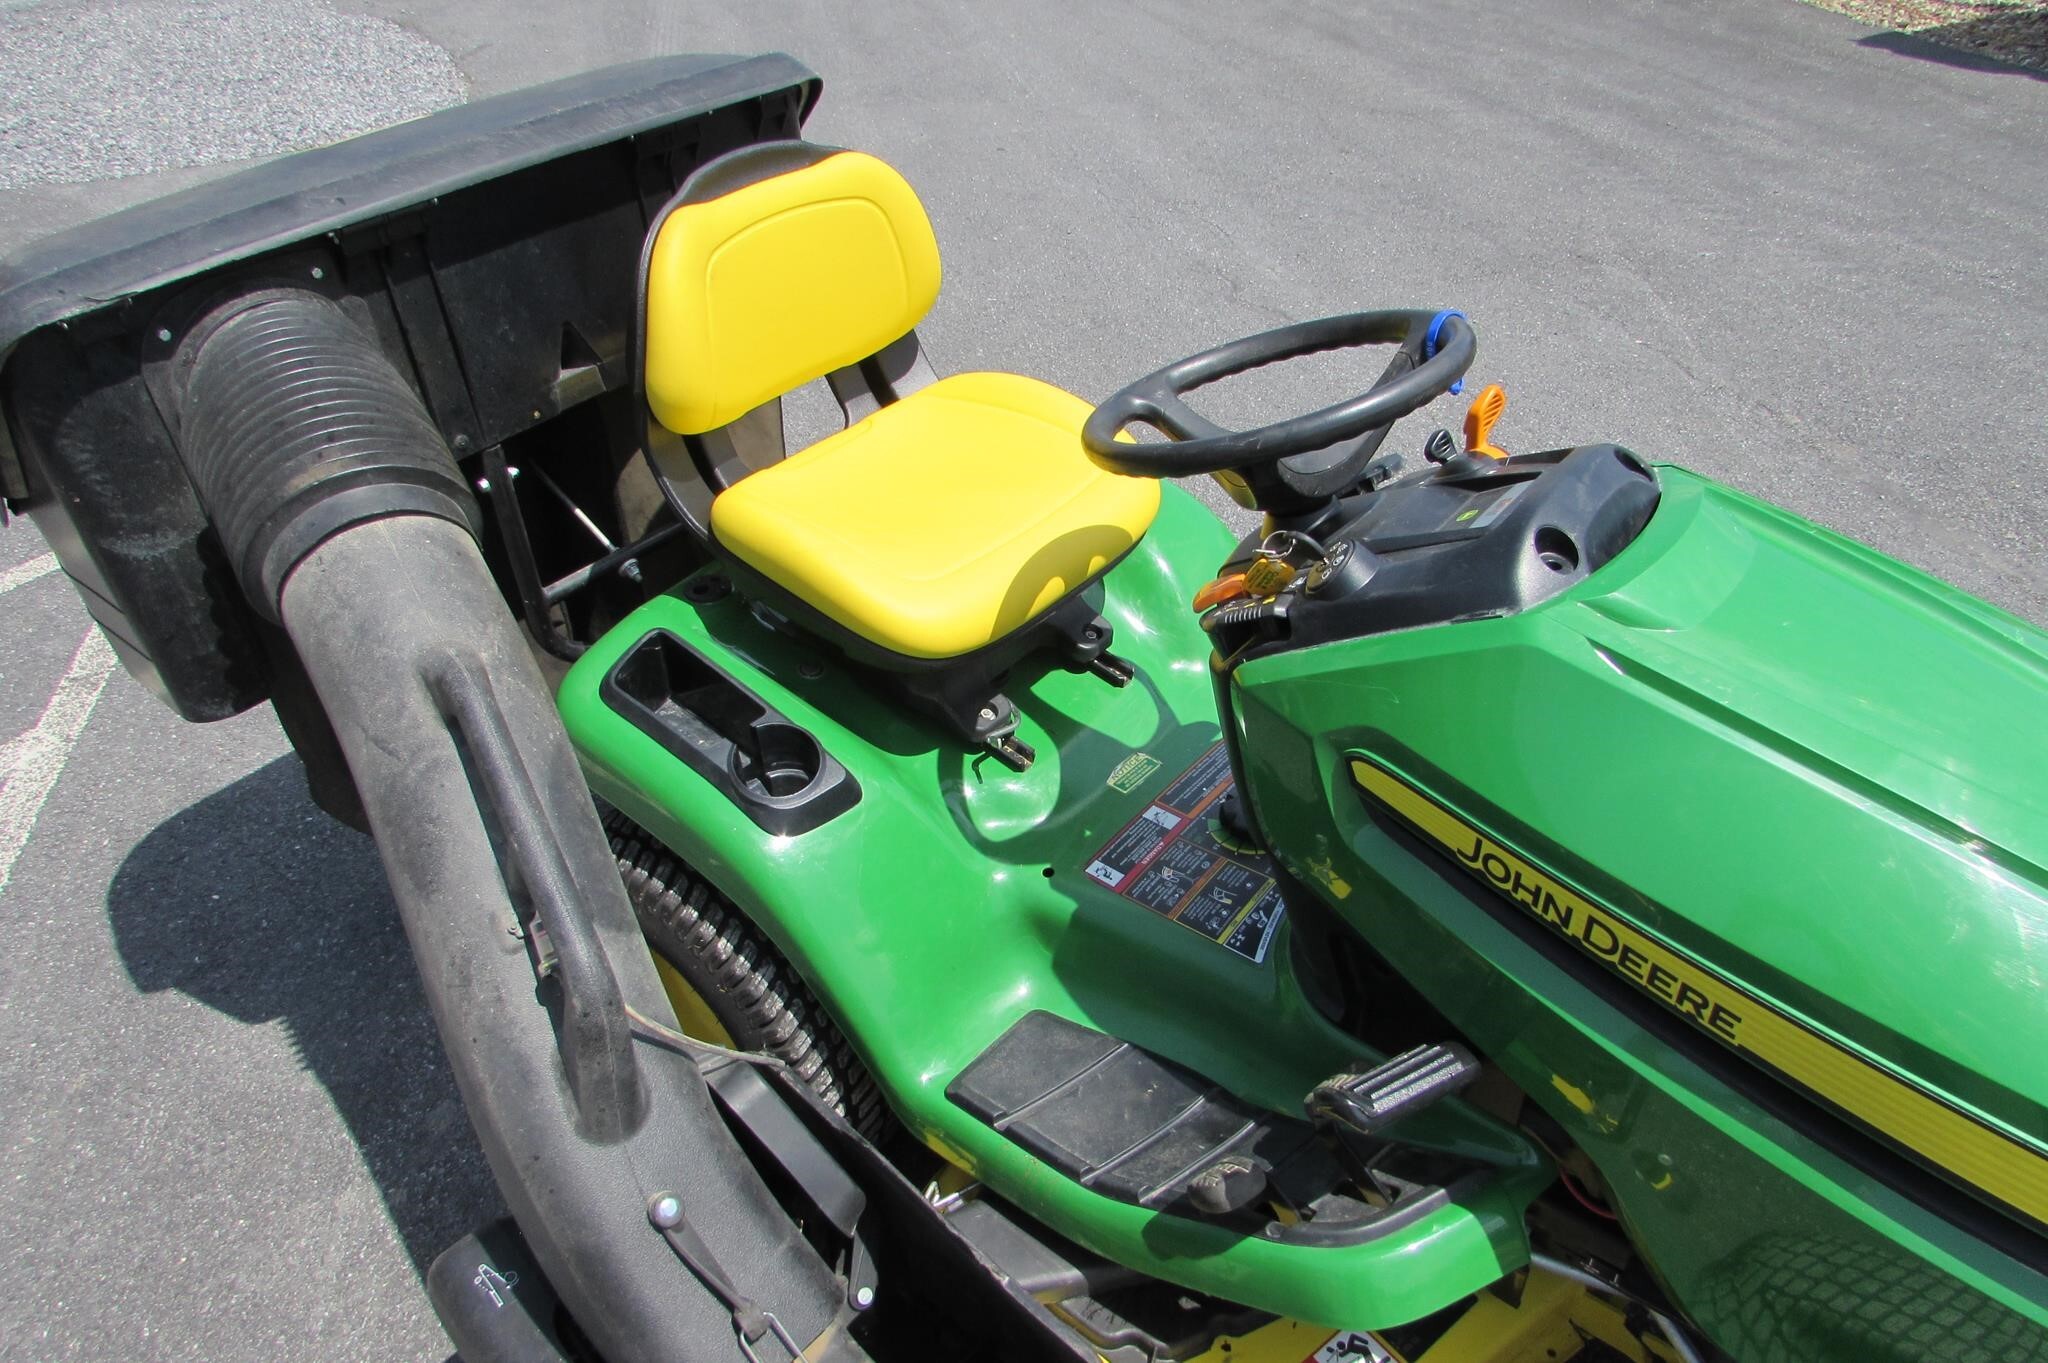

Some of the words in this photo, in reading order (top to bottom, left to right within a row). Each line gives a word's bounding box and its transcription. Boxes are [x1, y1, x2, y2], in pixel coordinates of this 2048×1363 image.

[1111, 754, 1142, 781] NOTICE
[1456, 837, 1574, 930] JOHN
[1583, 914, 1742, 1039] DEERE
